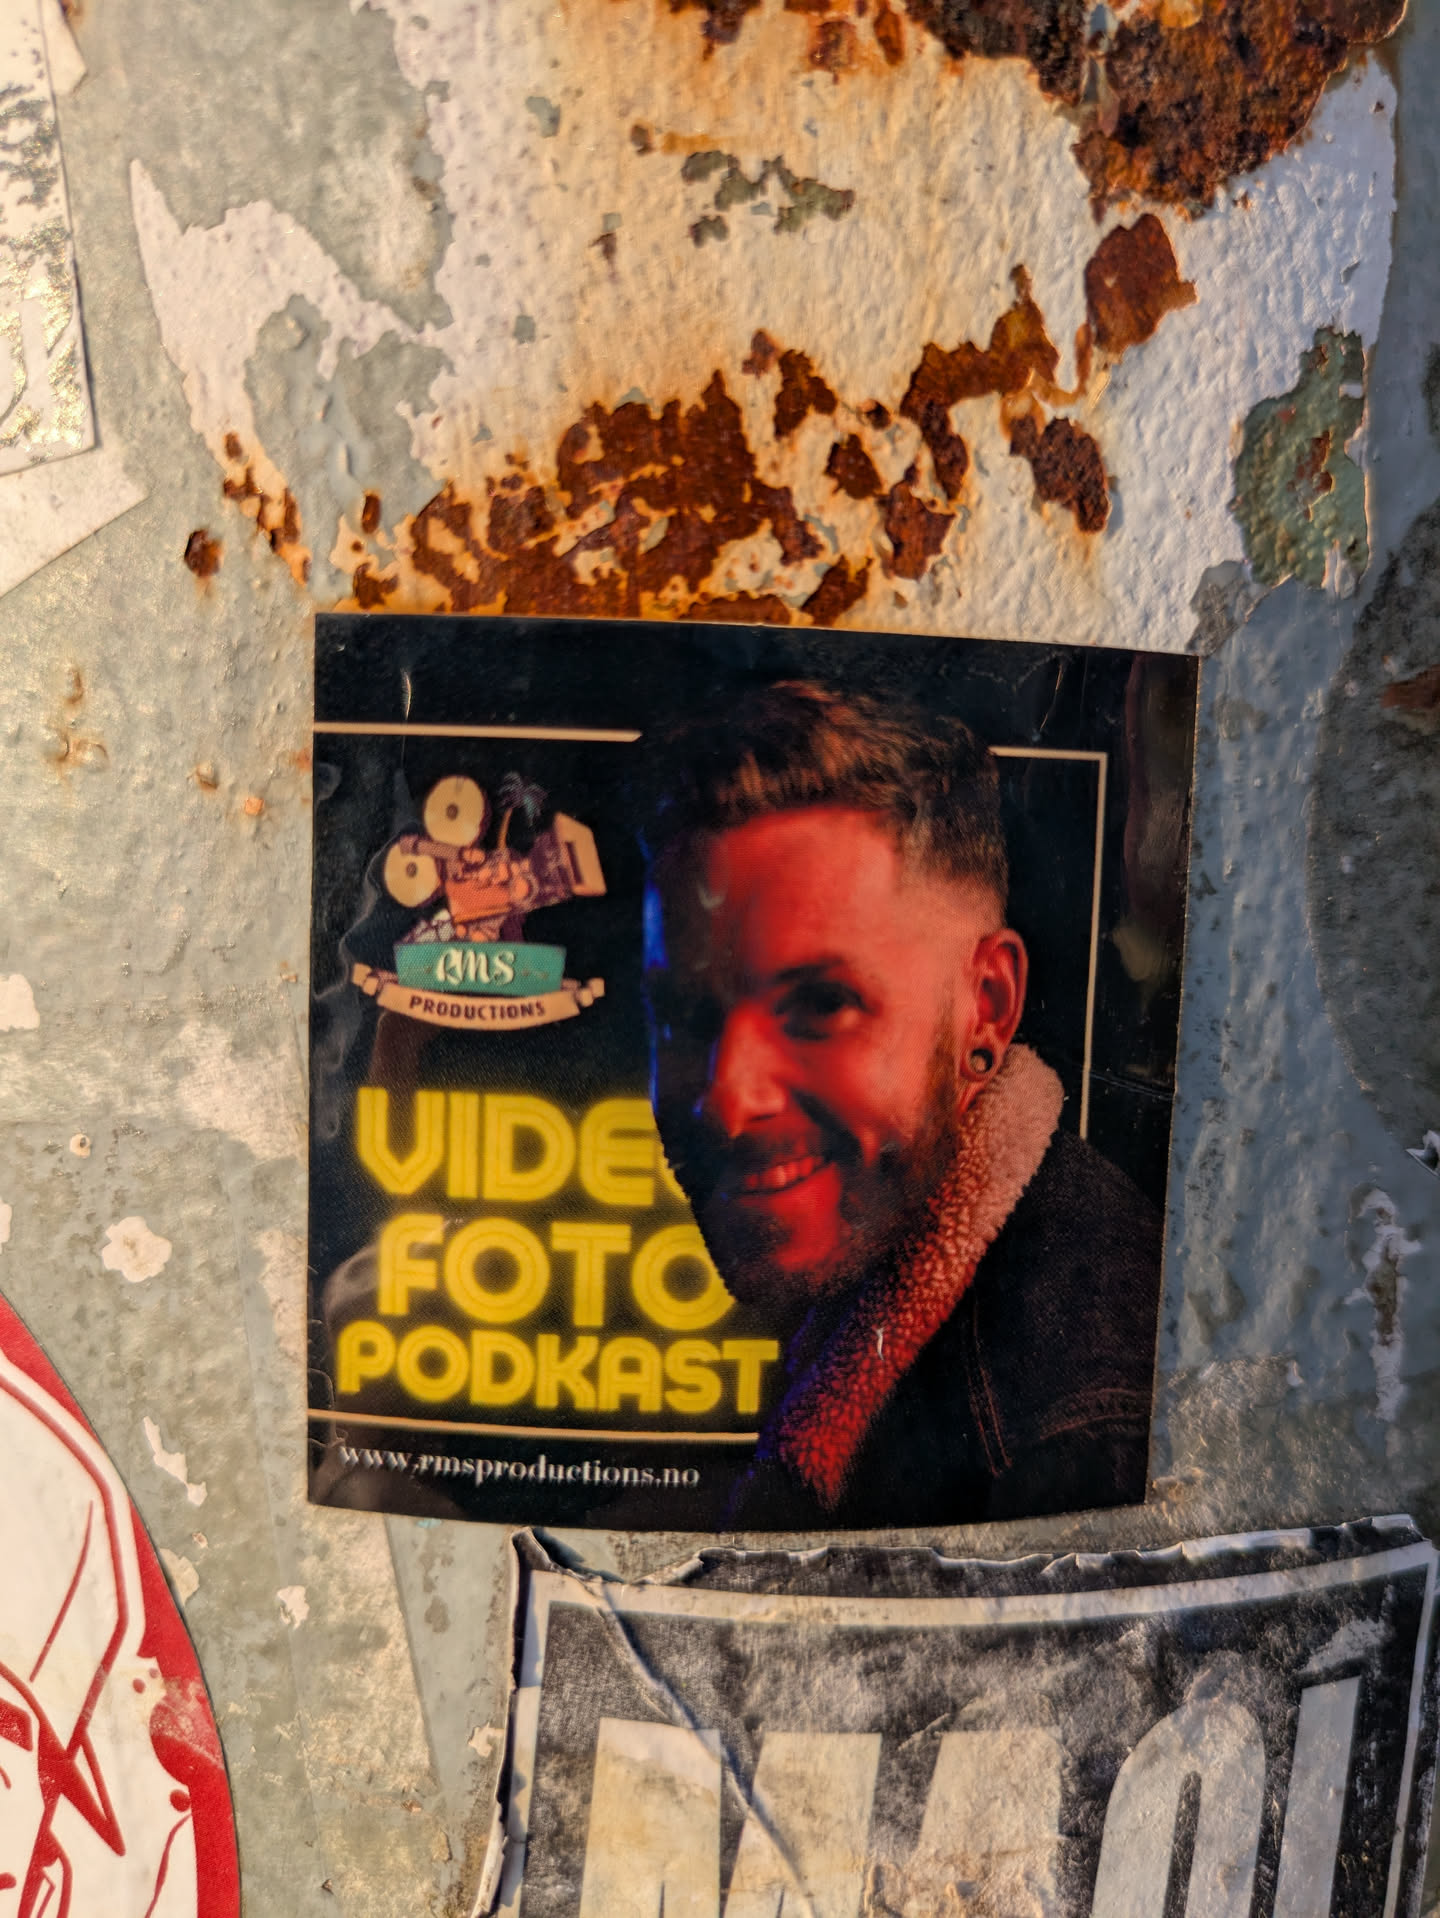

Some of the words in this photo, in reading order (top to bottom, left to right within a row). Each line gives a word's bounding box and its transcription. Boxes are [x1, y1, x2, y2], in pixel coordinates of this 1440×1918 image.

[408, 995, 546, 1021] PRODUCTIONS
[356, 1086, 692, 1207] VIDE
[336, 1319, 780, 1415] PODKAST
[337, 1444, 700, 1488] www.rmsproductions.no
